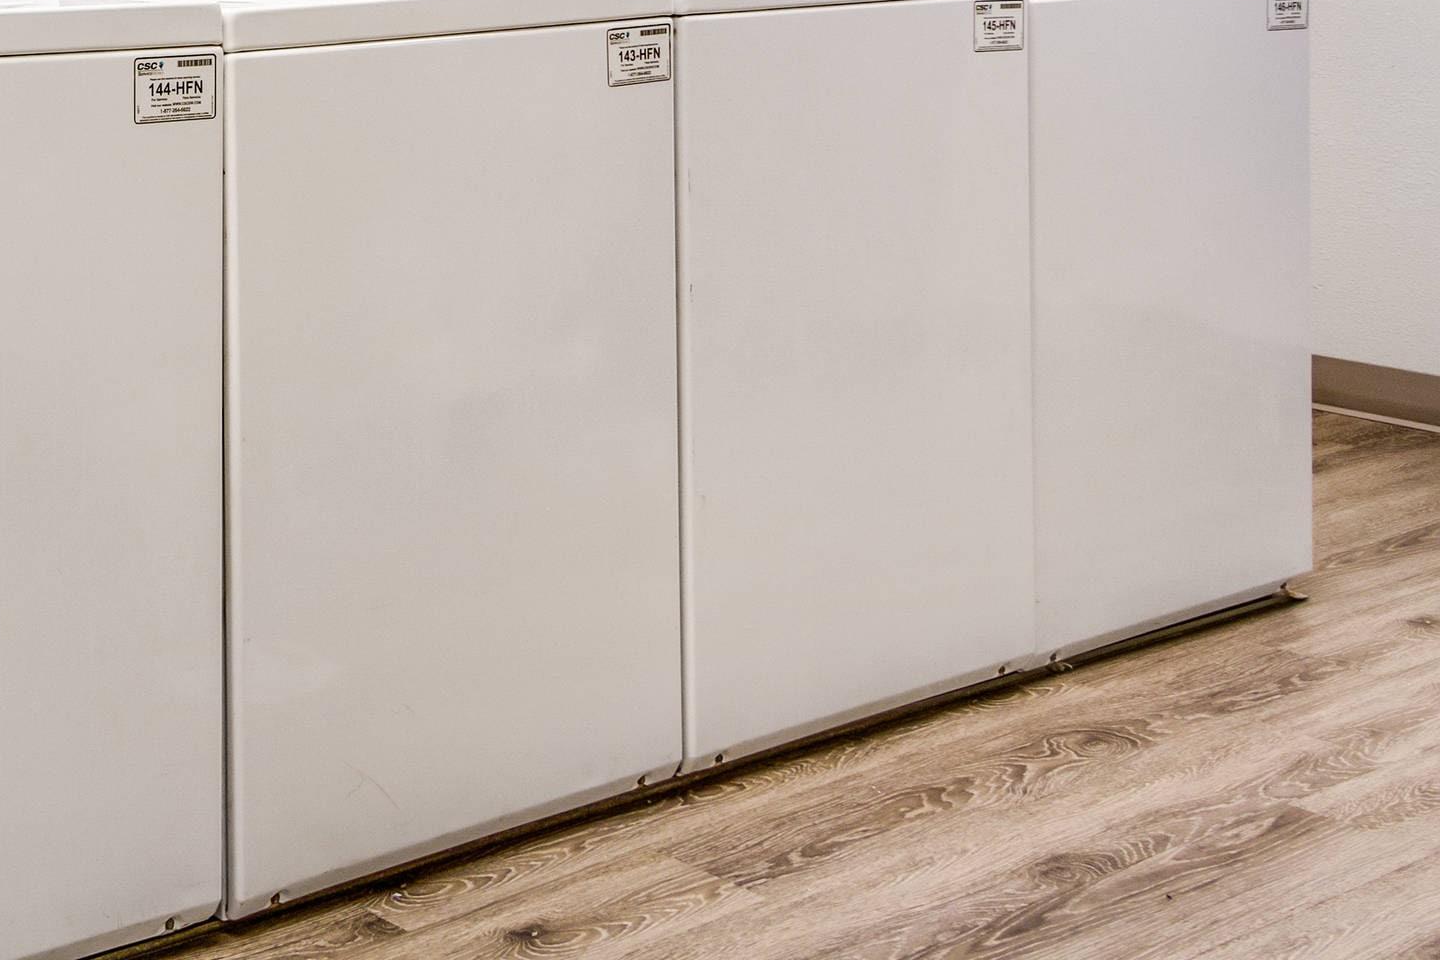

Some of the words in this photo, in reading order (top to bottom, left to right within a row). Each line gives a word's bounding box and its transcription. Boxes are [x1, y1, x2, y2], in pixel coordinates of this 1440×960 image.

[618, 47, 661, 62] 143-HFN
[137, 62, 158, 71] CSC
[148, 80, 203, 96] 144-HFN
